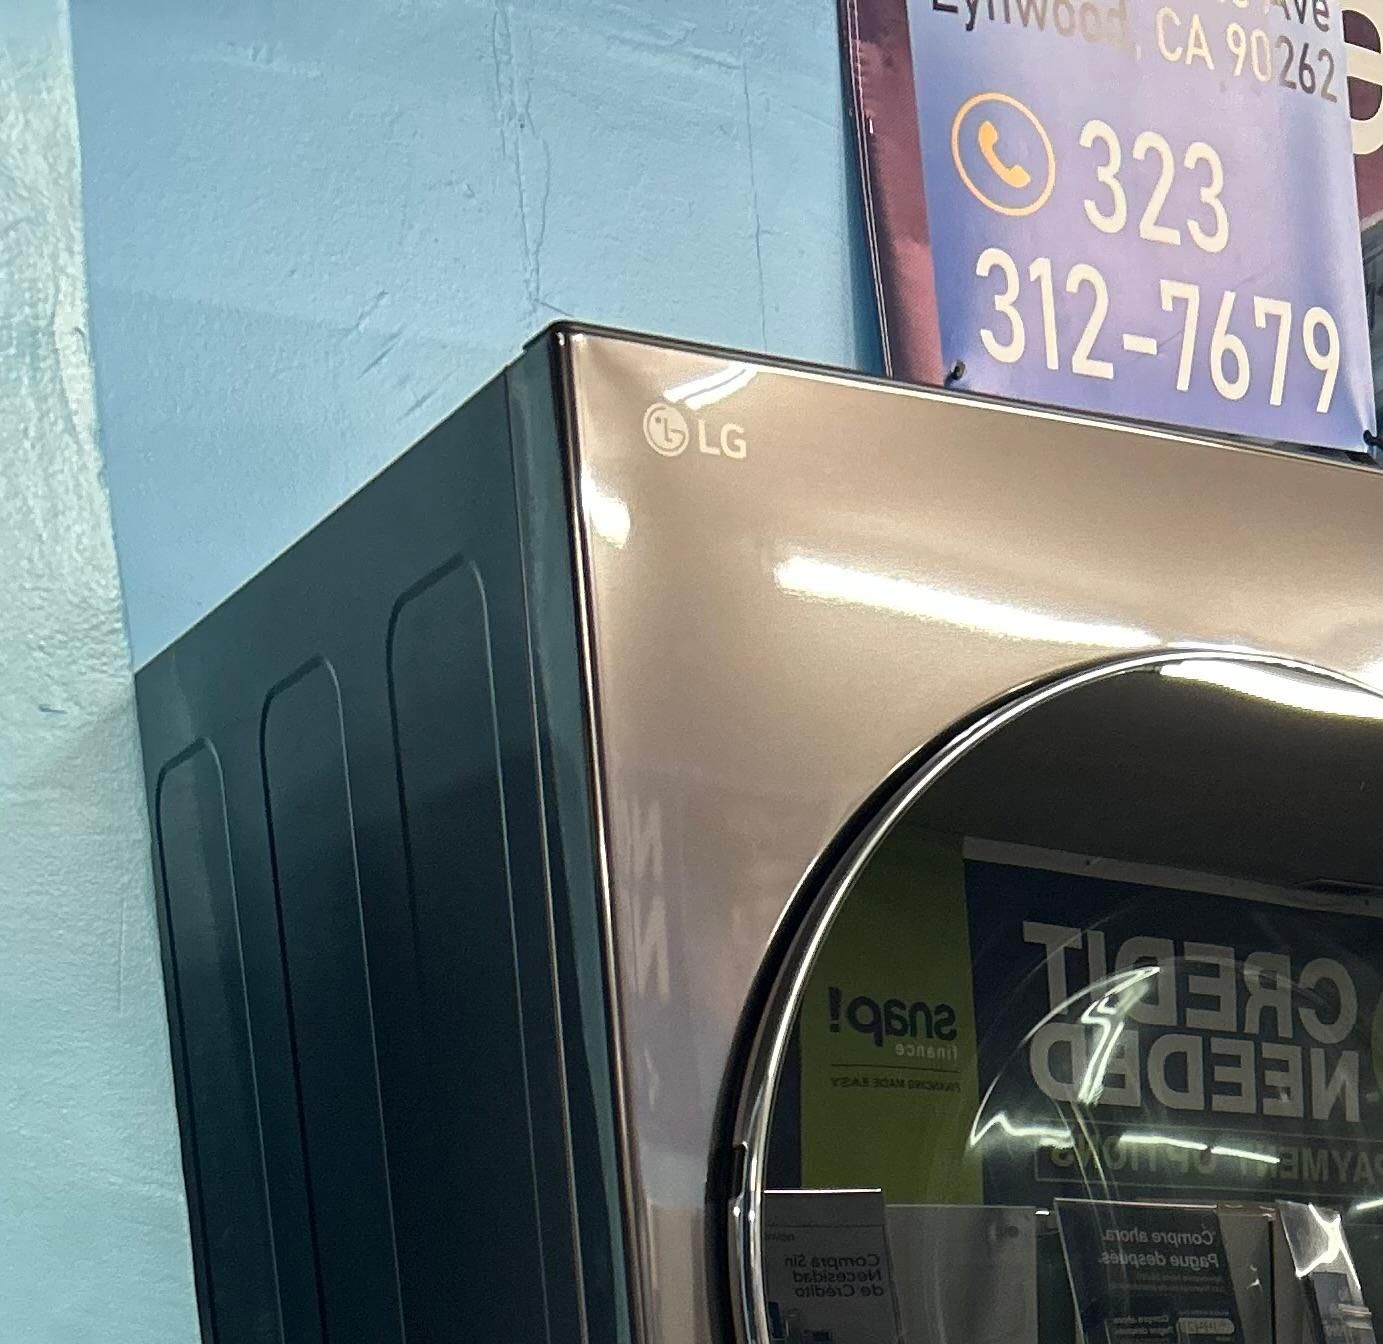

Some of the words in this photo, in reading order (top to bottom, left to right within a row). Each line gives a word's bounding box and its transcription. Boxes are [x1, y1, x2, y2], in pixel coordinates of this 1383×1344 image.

[1156, 6, 1215, 71] CA
[1226, 22, 1338, 103] 90262
[1079, 118, 1231, 254] 323
[974, 247, 1341, 414] 312-7679
[698, 418, 747, 460] LG
